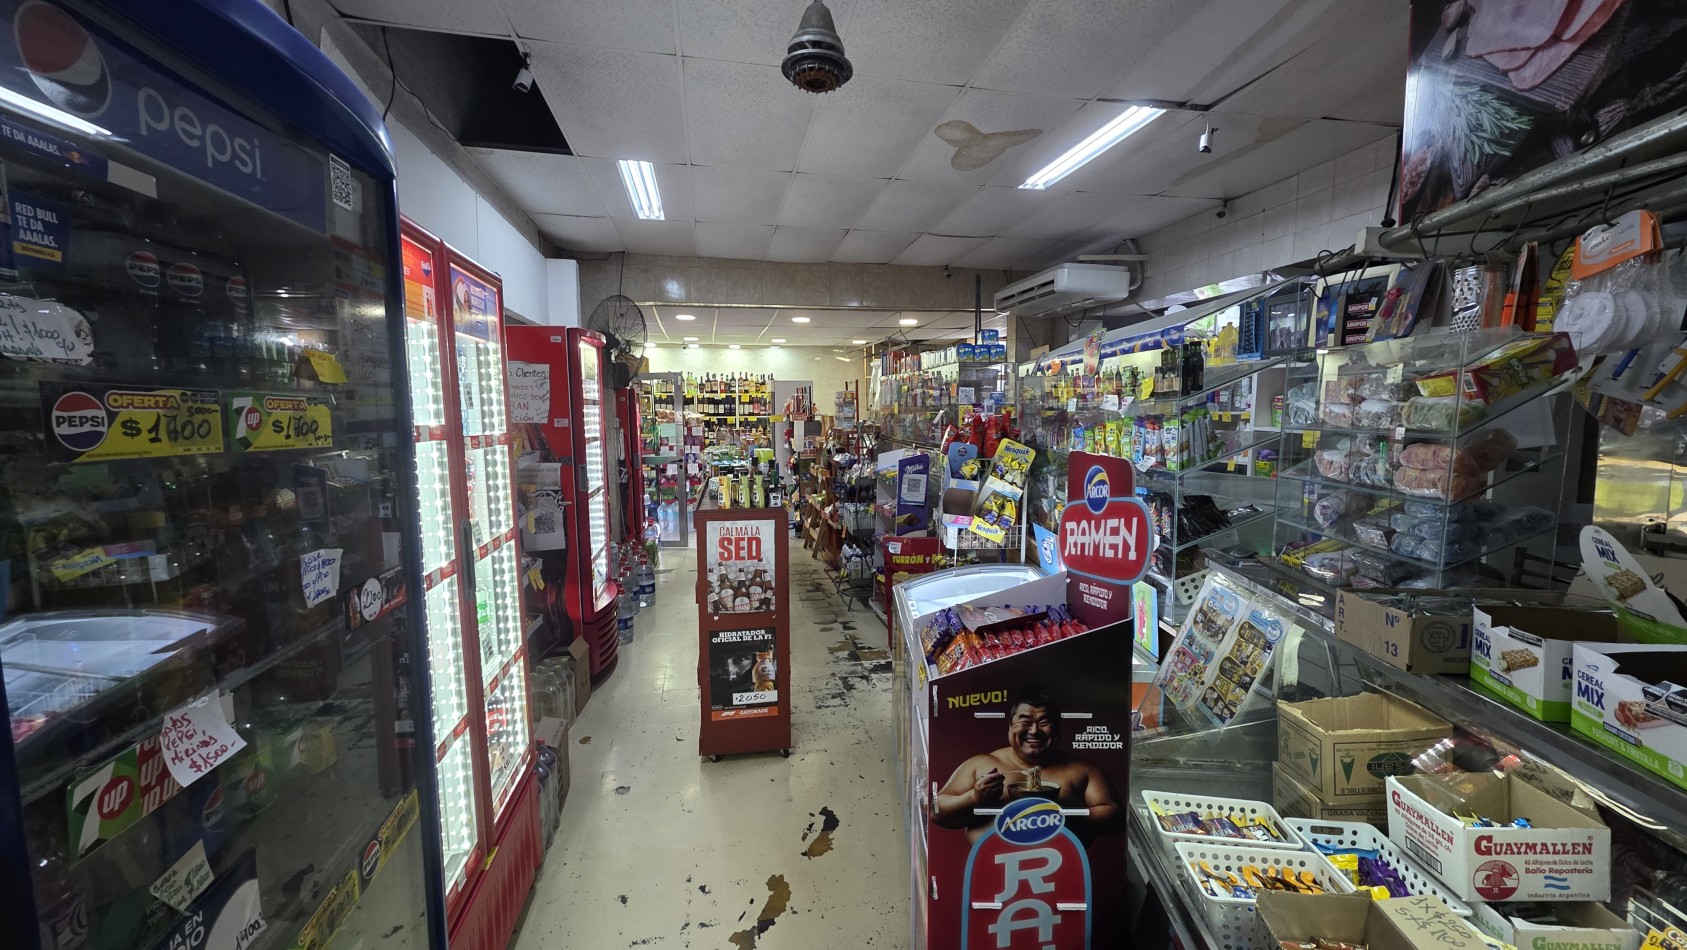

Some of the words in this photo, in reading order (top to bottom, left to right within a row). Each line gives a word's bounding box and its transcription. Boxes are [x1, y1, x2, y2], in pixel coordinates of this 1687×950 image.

[138, 86, 264, 180] pepsi
[15, 202, 34, 218] RED
[36, 206, 59, 224] BULL
[16, 215, 28, 229] TE
[30, 219, 44, 232] DA
[19, 231, 58, 248] AAALAS.
[107, 394, 179, 410] OFERTA
[265, 400, 306, 411] OFERTA
[55, 415, 106, 428] PEPSI
[1004, 444, 1030, 456] Nesquik
[1087, 483, 1108, 498] ARCOR
[751, 526, 760, 536] LA
[975, 524, 999, 535] Nesquik
[1065, 517, 1137, 560] RAMEN
[1592, 536, 1613, 549] CEREAL
[719, 537, 762, 561] SED
[1595, 544, 1620, 564] MIX
[1384, 641, 1398, 657] 13
[1475, 637, 1491, 660] MIX
[1577, 670, 1604, 691] CEREAL
[947, 690, 1008, 709] NUEVO!
[1577, 680, 1605, 711] MIX
[1075, 731, 1111, 741] RÁPIDO
[1072, 741, 1123, 749] RENDIDOR
[1000, 813, 1061, 833] ARCOR
[1392, 790, 1454, 846] GUAYMALLEN
[1474, 835, 1593, 856] GUAYMALLEN
[1548, 867, 1593, 875] Repostería
